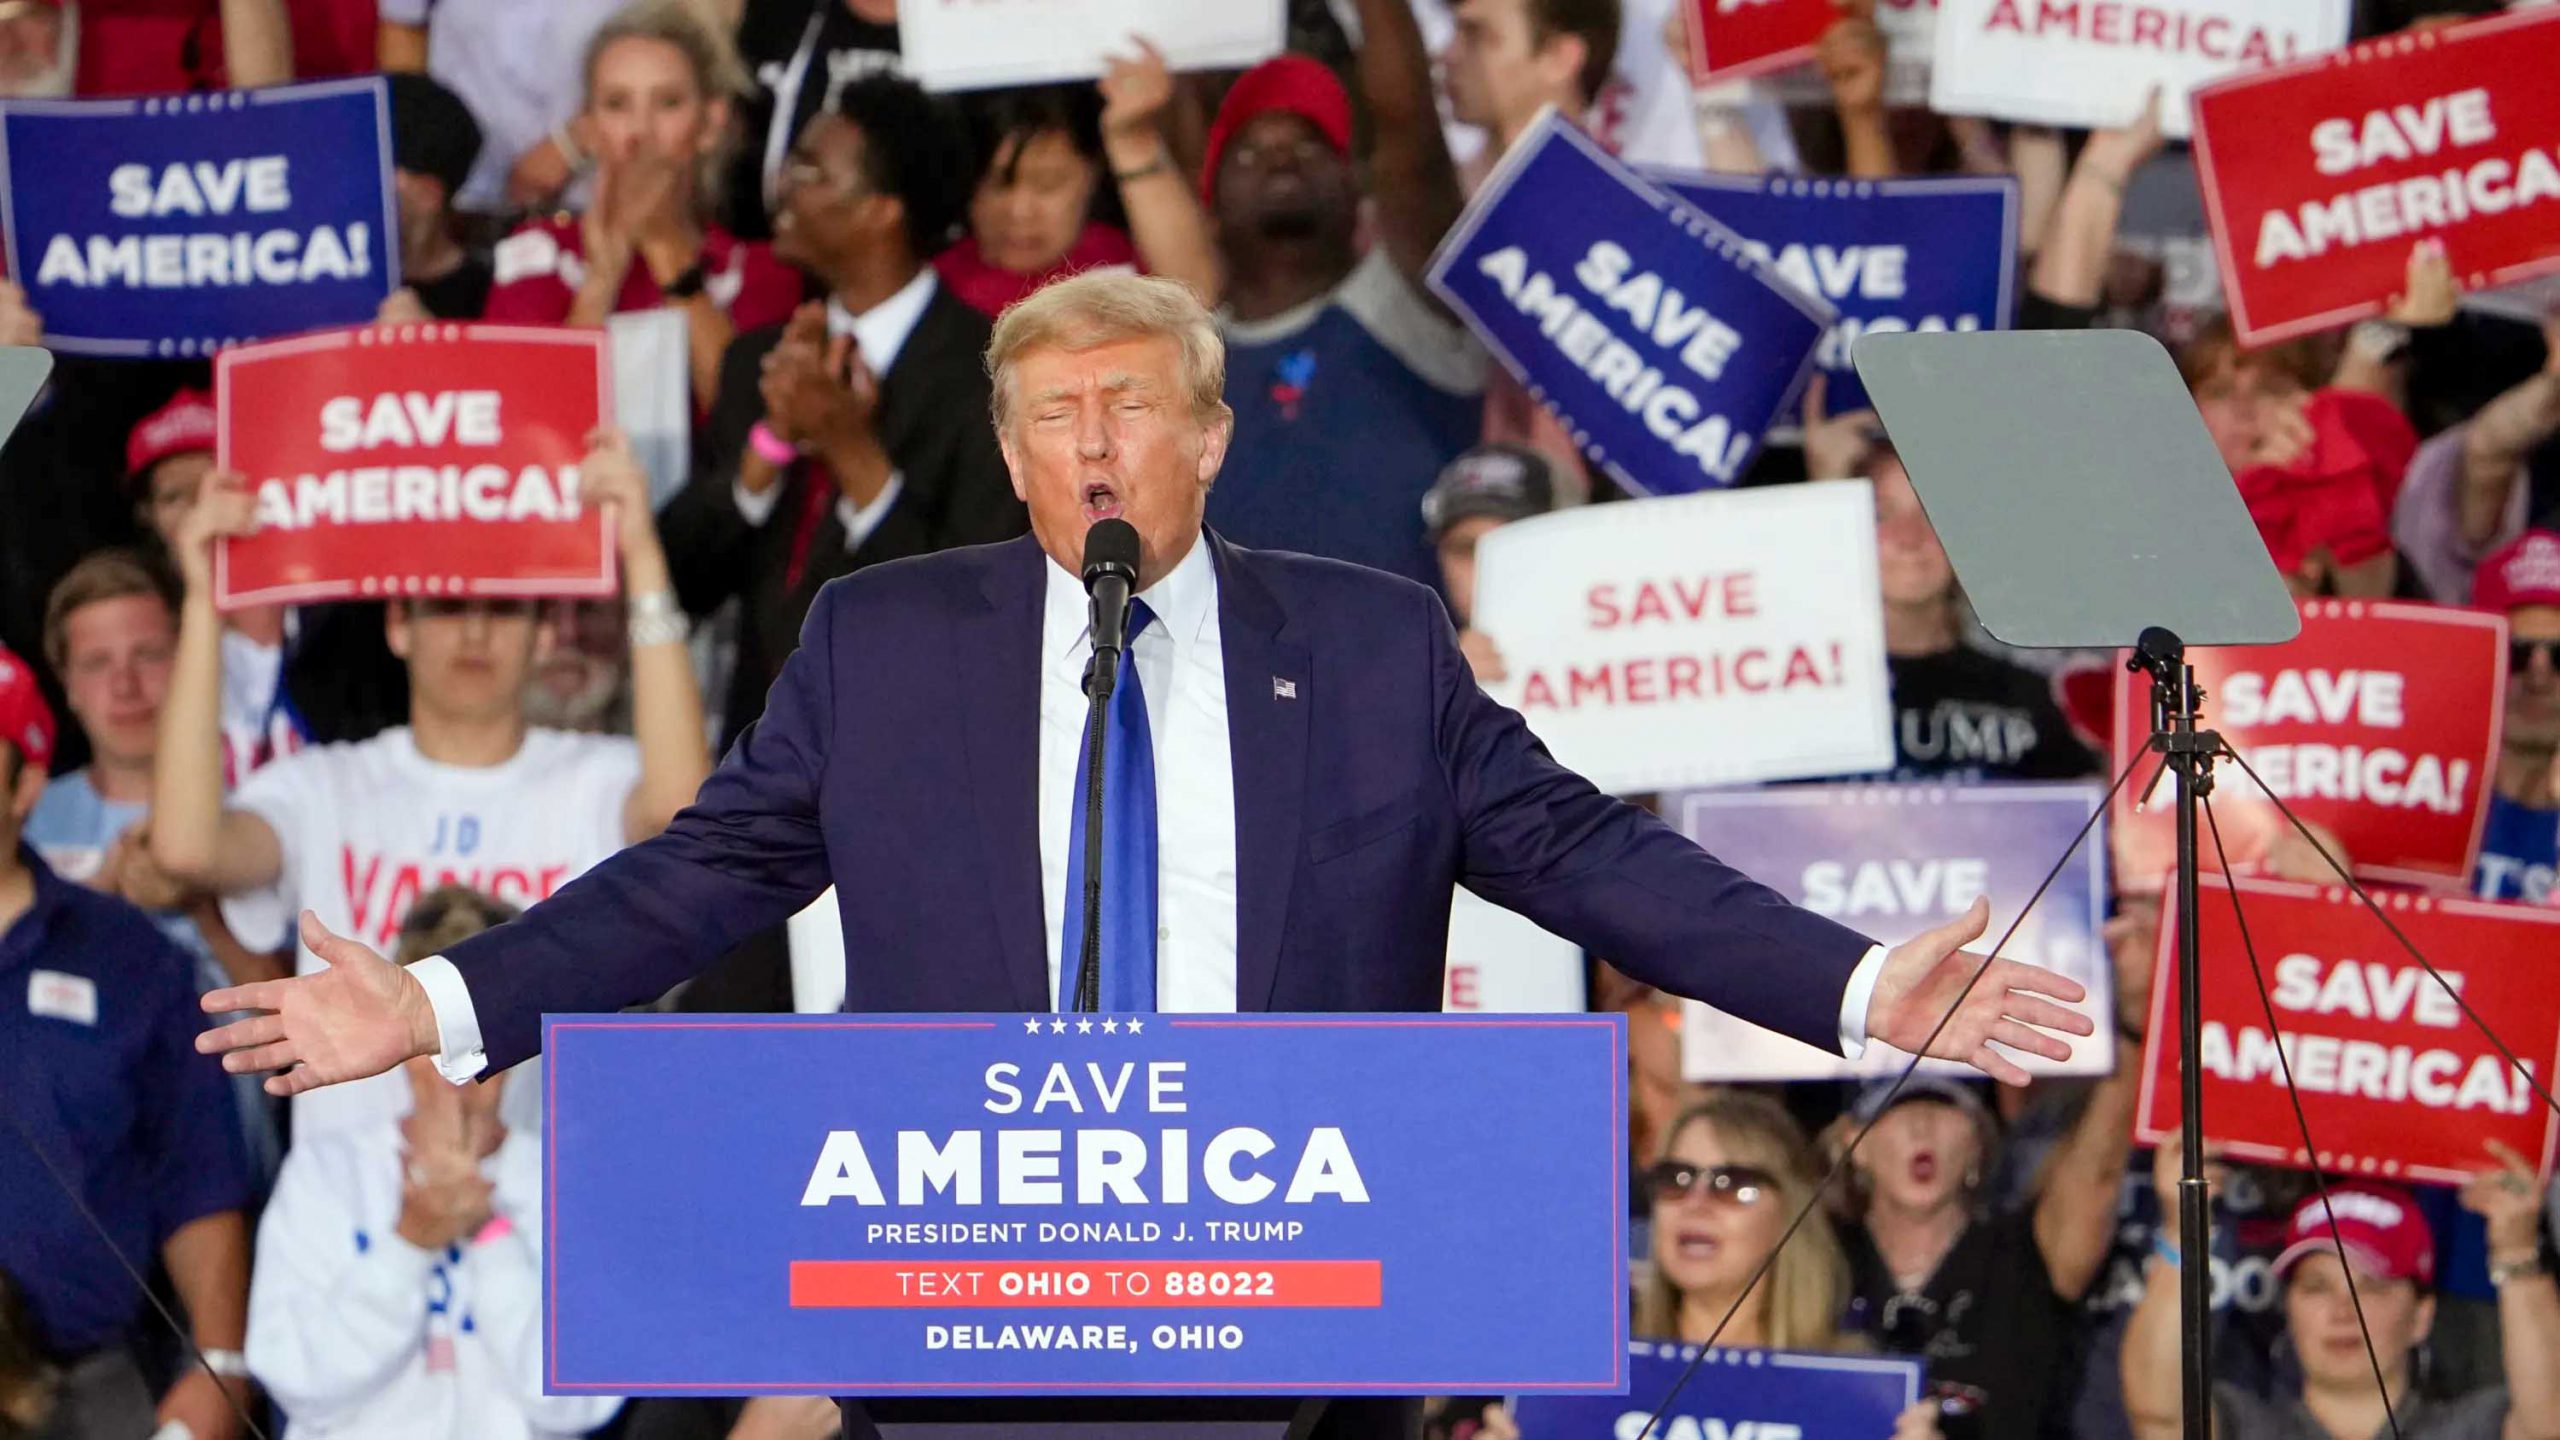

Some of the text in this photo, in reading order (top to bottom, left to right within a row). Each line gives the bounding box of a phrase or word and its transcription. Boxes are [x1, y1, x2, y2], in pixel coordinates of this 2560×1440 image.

[1983, 0, 2296, 68] AMERICA!
[2310, 87, 2497, 176] SAVE
[109, 155, 292, 217] SAVE
[2254, 147, 2560, 270] AMERICA
[37, 221, 371, 288] AMERICA!
[1574, 239, 1743, 382] SAVE
[1476, 244, 1750, 481] AMERICA!
[319, 389, 503, 452] SAVE
[255, 463, 582, 530] AMERICA!
[1587, 572, 1759, 630] SAVE
[1522, 642, 1844, 709] AMERICA!
[2221, 669, 2404, 728] SAVE
[1901, 700, 2038, 763] UMP
[2148, 743, 2470, 815] MERICA!
[1801, 857, 1990, 916] SAVE
[2271, 953, 2465, 1029] SAVE
[983, 1061, 1188, 1114] SAVE
[2178, 1020, 2535, 1114] AMERICA!
[799, 1126, 1371, 1206] AMERICA
[866, 1221, 1304, 1244] PRESIDENT DONALD J. TRUMP
[895, 1271, 1275, 1297] TEXT OHIO TO 88022
[926, 1325, 1244, 1355] DELAWARE, OHIO
